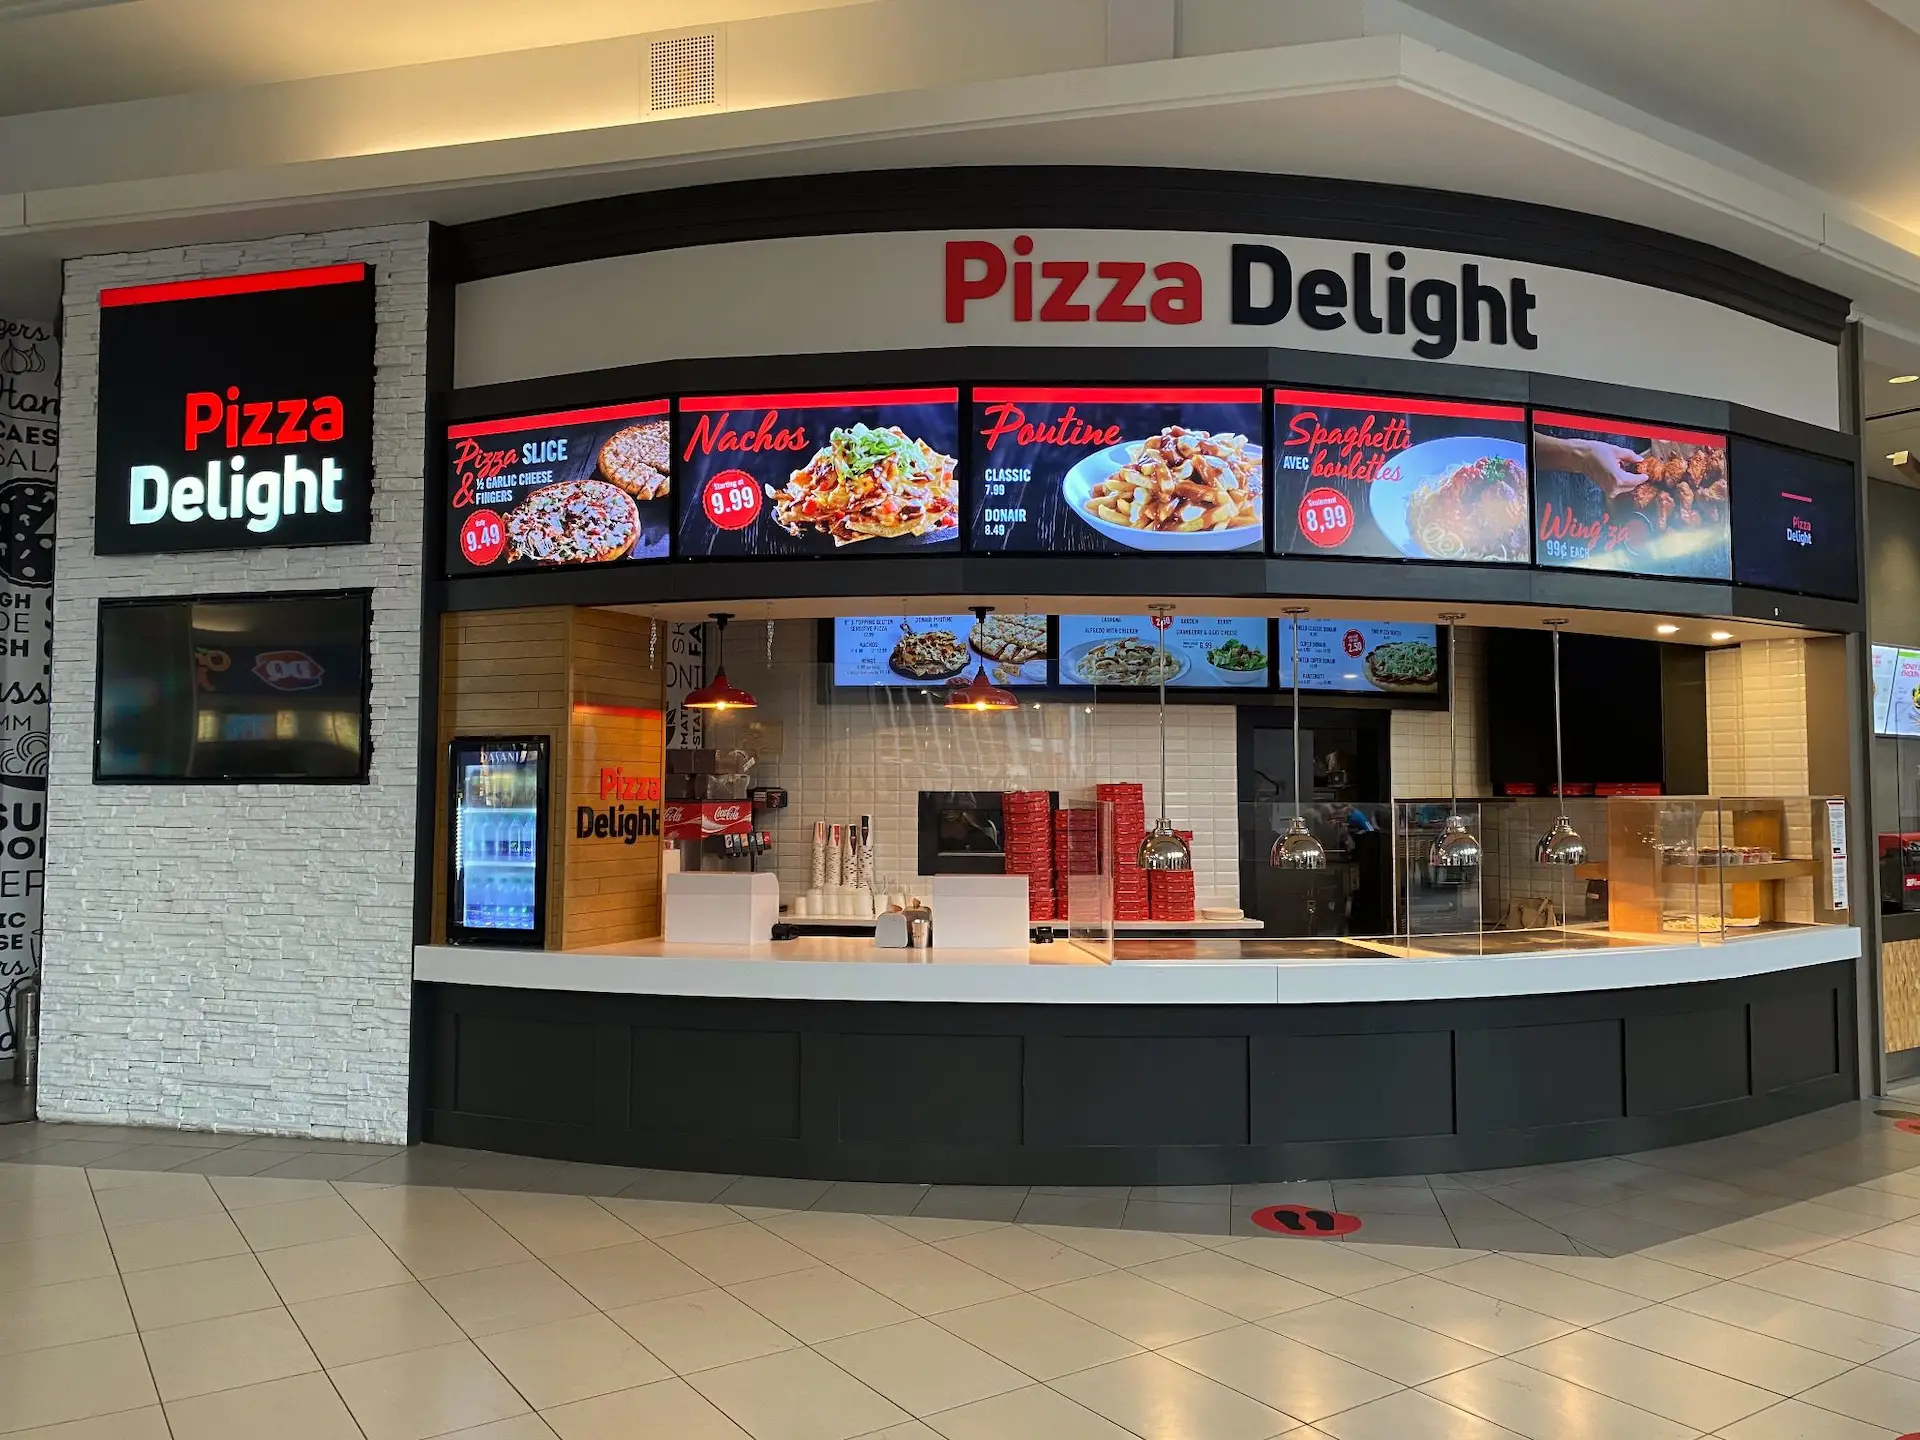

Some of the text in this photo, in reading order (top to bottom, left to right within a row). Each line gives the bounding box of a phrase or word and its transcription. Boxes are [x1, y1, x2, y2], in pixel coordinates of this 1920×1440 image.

[945, 235, 1538, 359] Pizza Delight
[185, 386, 345, 451] Pizza
[980, 403, 1123, 451] Poutine
[683, 410, 810, 462] Nachos
[1284, 411, 1413, 457] Spaghetti
[453, 438, 568, 478] Pizza SLICE
[1283, 449, 1403, 484] AVEC boulettes
[486, 475, 517, 489] GARLIC
[519, 470, 553, 486] CHEESE
[713, 480, 737, 491] Starting
[984, 468, 1032, 482] CLASSIC
[129, 455, 344, 533] Delight
[452, 472, 474, 509] &
[476, 489, 513, 505] FINGERS
[711, 487, 755, 515] 9.99
[985, 484, 1005, 496] 7.99
[984, 509, 1027, 522] DONAIR
[1306, 504, 1347, 532] 8,99
[1540, 502, 1630, 552] Wing'za
[1792, 516, 1812, 532] Pizza
[466, 523, 500, 552] 9.49
[984, 525, 1005, 536] 8.49
[1786, 528, 1812, 546] Delight
[1546, 540, 1590, 560] 99¢ EACH
[1347, 641, 1363, 653] 2.50
[480, 751, 519, 764] DASANI
[601, 766, 661, 801] Pizza
[577, 804, 660, 845] Delight
